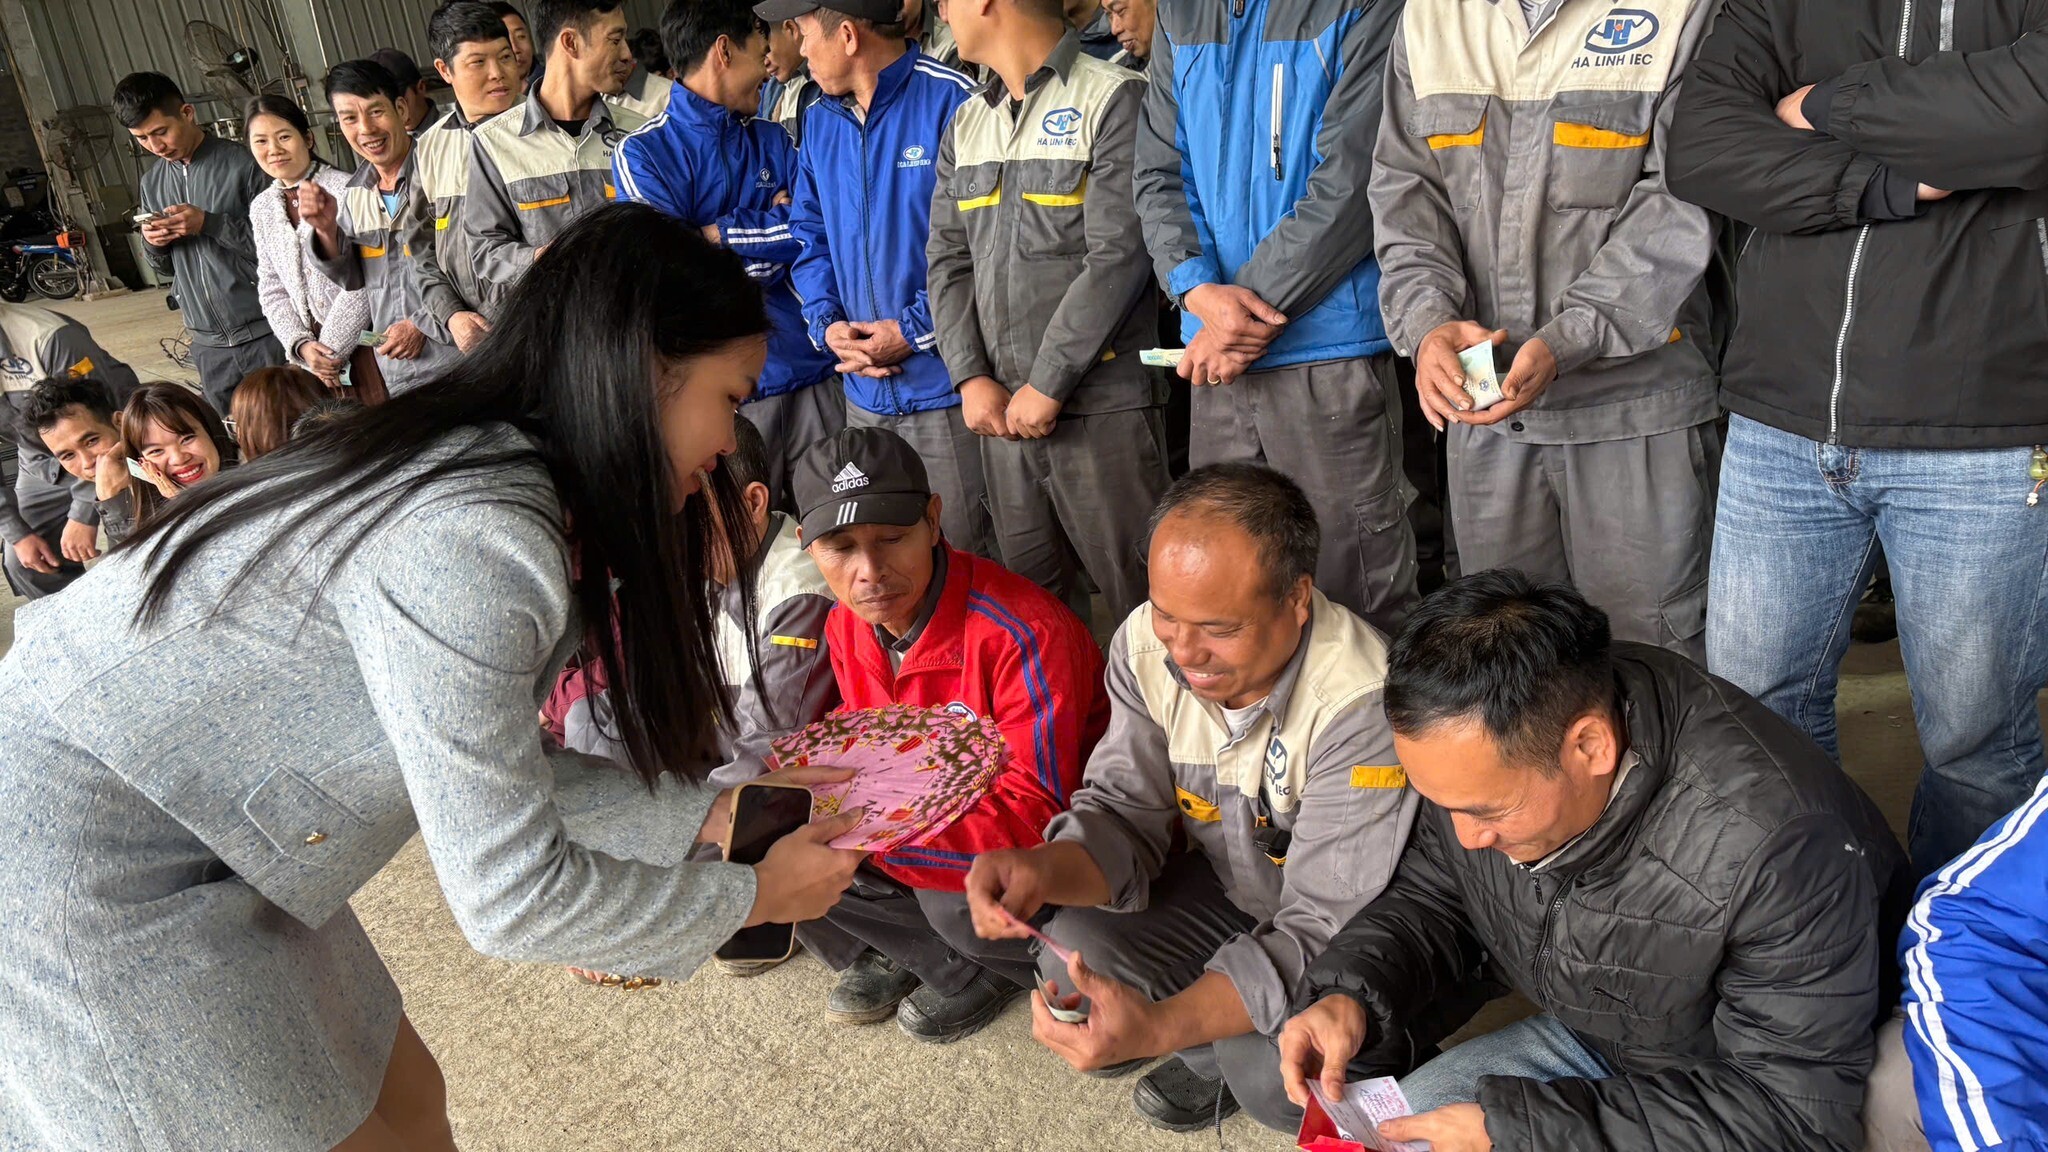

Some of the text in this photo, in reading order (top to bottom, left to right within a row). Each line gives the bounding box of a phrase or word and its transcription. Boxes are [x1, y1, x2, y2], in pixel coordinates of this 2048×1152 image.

[1571, 53, 1653, 69] HA LINH IEC
[1037, 138, 1048, 146] HA
[1065, 137, 1077, 146] IEC
[832, 476, 870, 493] adidas
